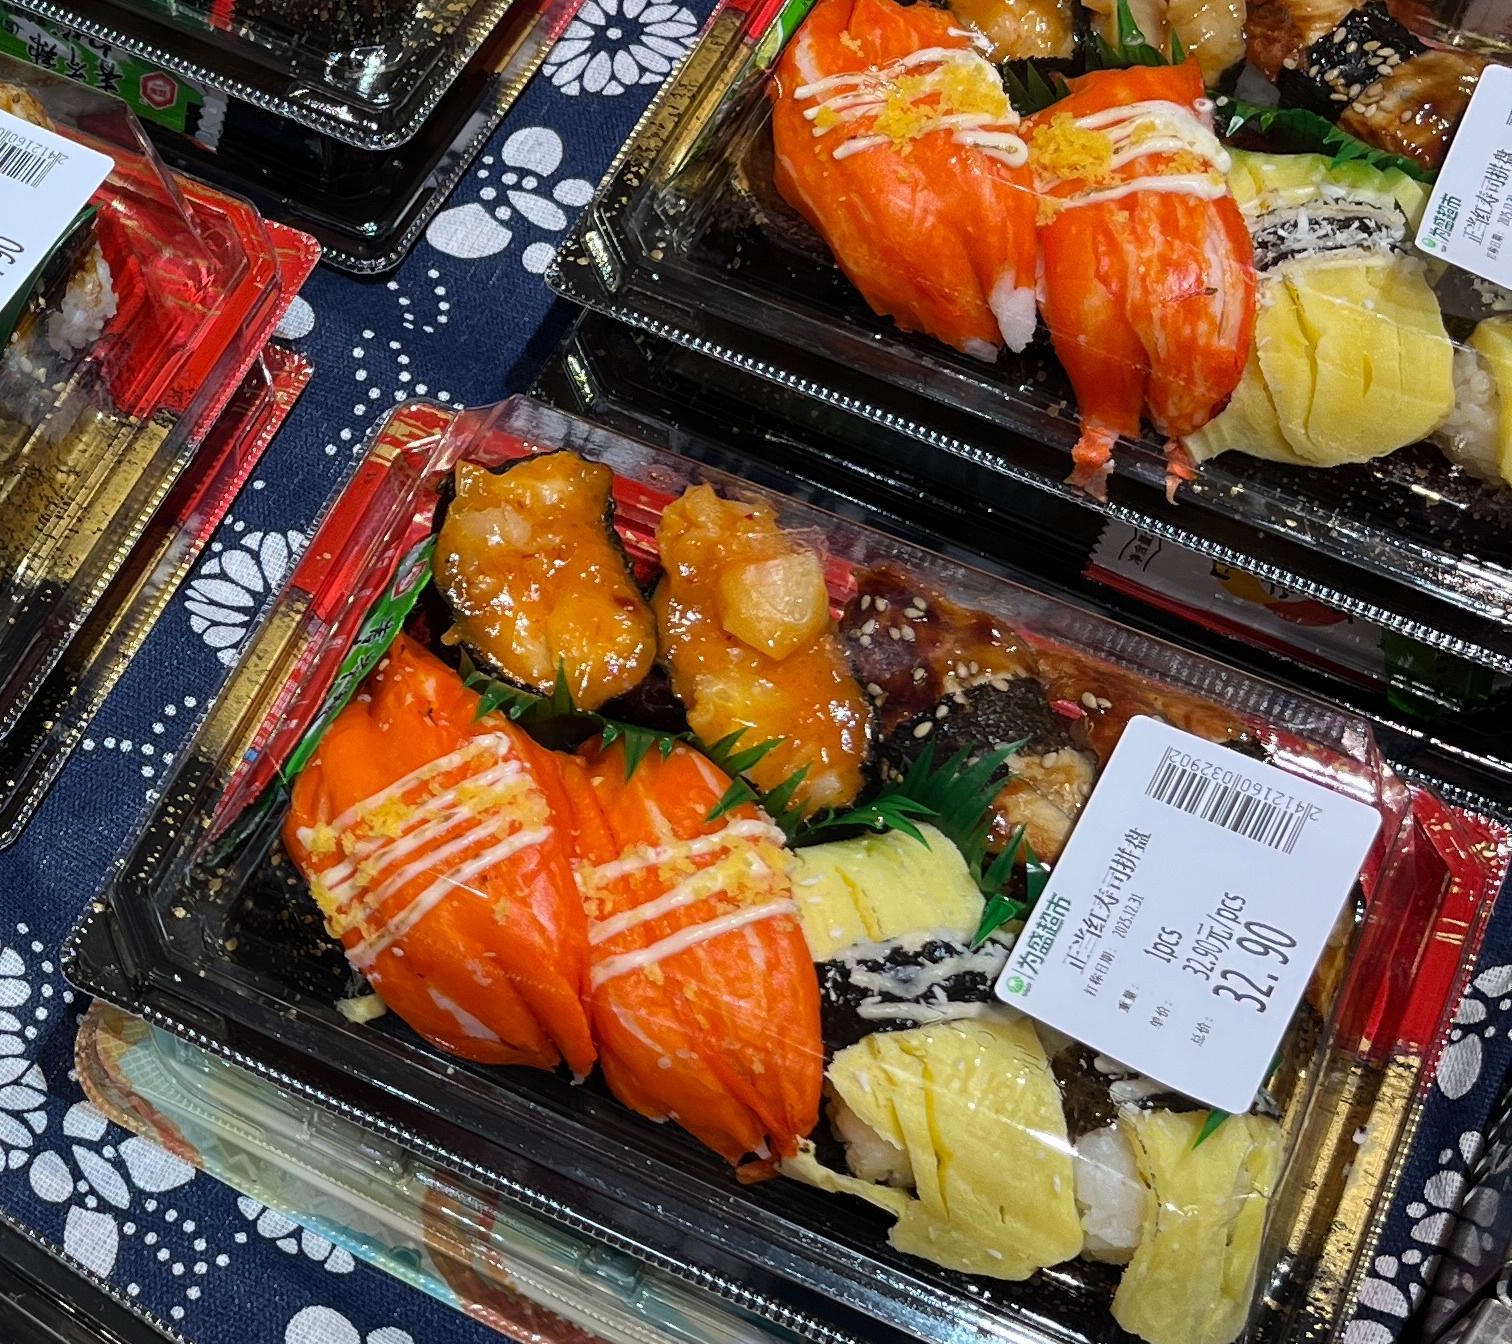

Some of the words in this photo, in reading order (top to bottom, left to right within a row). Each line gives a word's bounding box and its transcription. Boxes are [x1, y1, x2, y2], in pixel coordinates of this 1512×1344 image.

[1432, 193, 1462, 242] 为盛超市
[1016, 891, 1071, 975] 为盛超市
[1062, 826, 1152, 974] 正当红寿司拼盘
[1110, 892, 1145, 939] 2025.12.31
[1181, 890, 1246, 981] 32.90元/pcs
[1142, 925, 1183, 964] 1pcs
[1211, 920, 1297, 1013] 32.90
